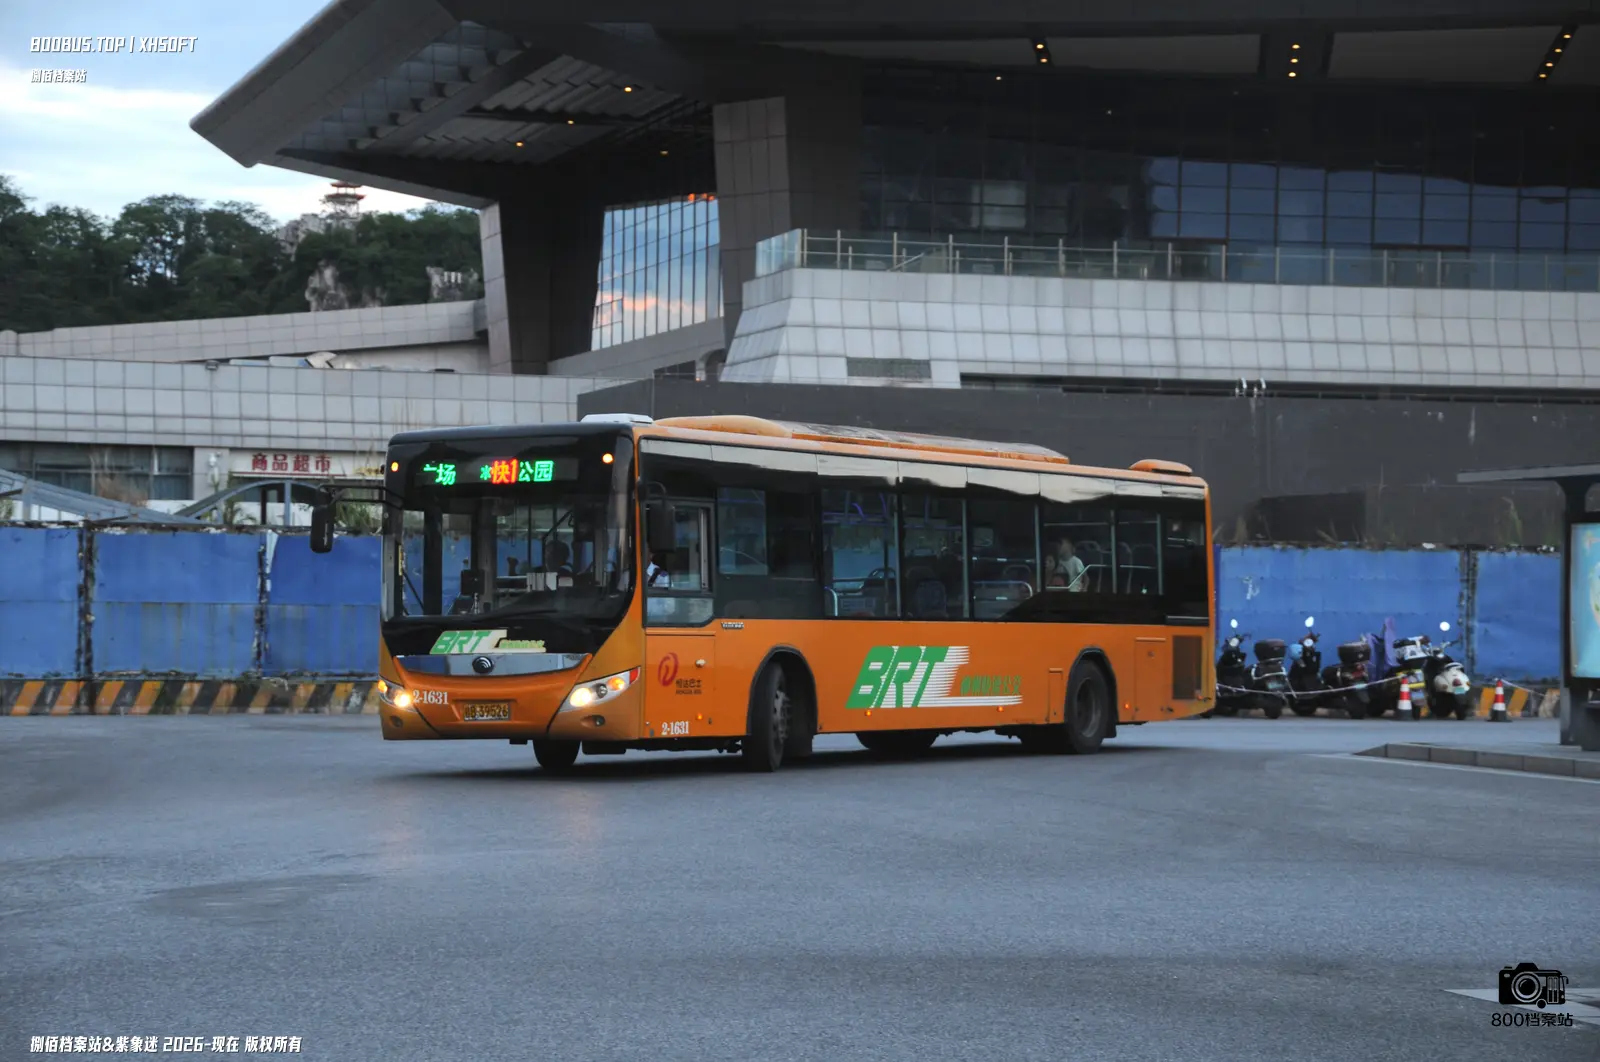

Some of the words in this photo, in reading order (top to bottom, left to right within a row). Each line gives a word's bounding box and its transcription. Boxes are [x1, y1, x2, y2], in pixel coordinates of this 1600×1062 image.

[251, 452, 333, 473] 商品超市
[430, 630, 491, 654] BRT
[845, 645, 949, 709] BRT
